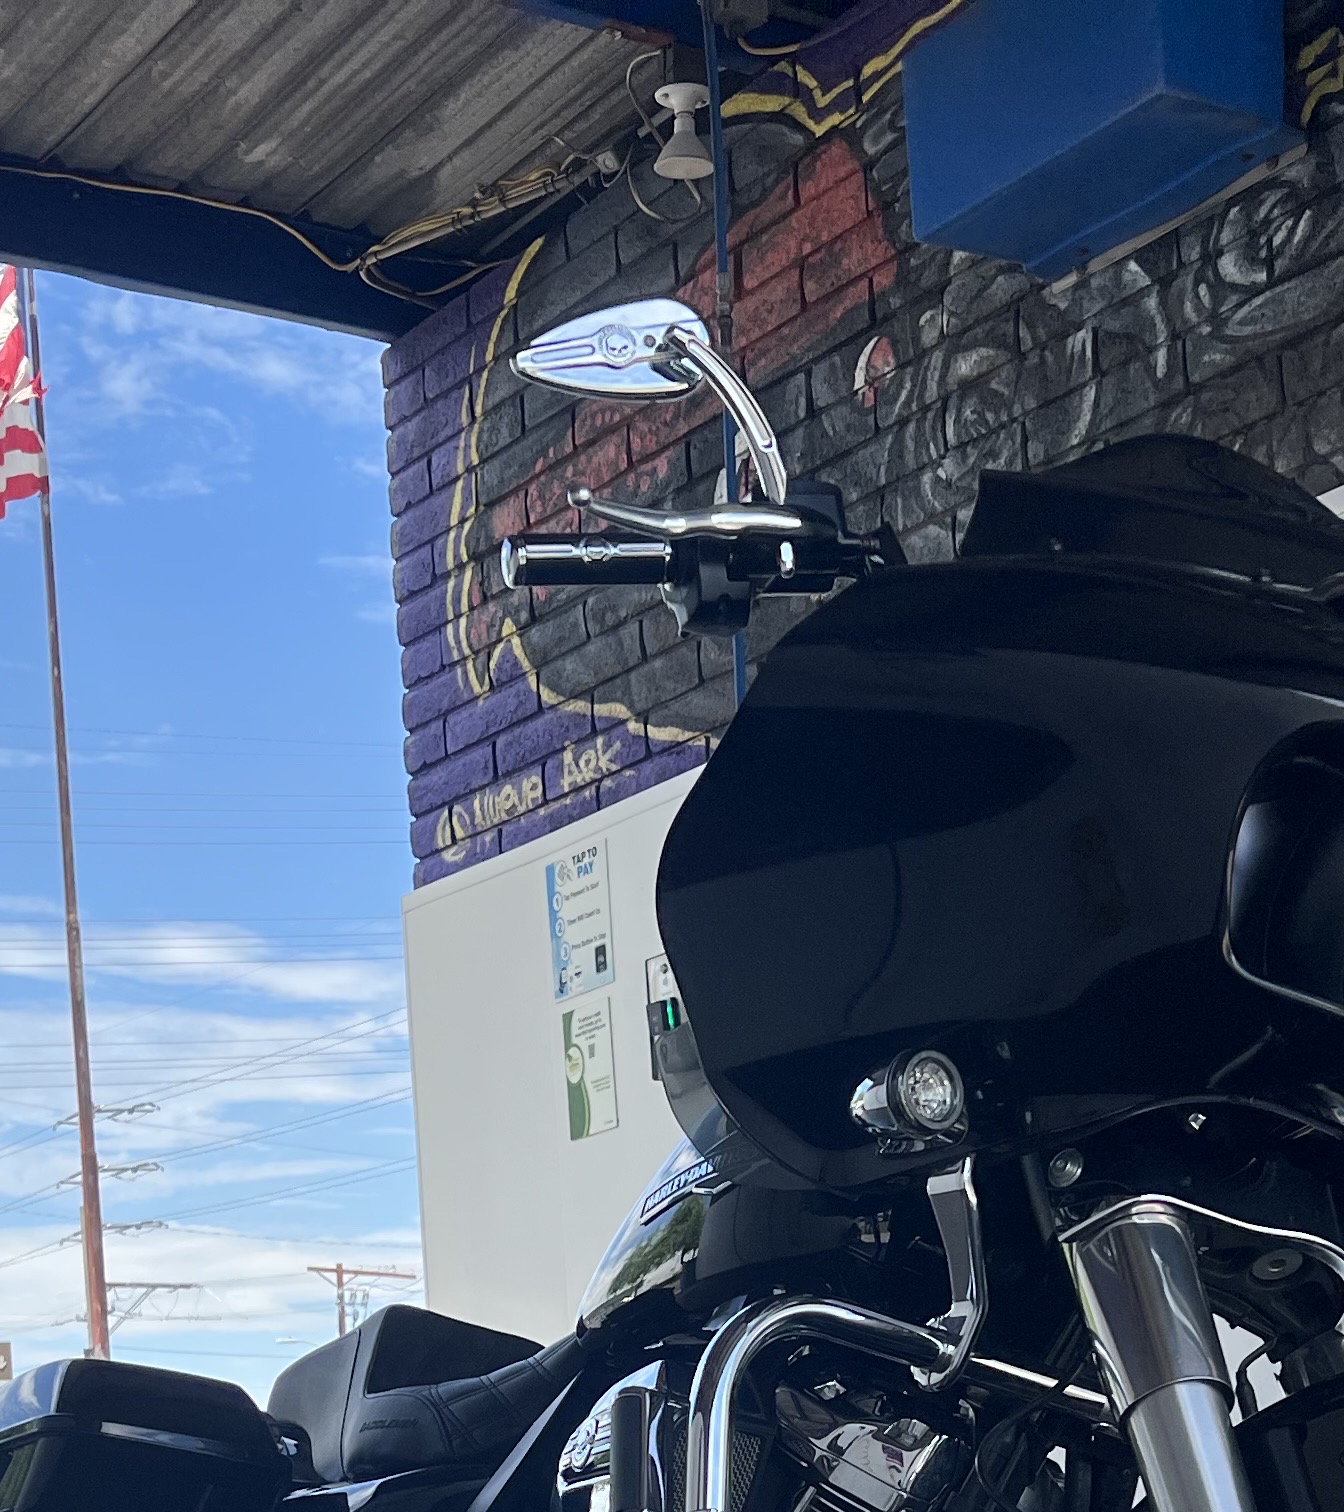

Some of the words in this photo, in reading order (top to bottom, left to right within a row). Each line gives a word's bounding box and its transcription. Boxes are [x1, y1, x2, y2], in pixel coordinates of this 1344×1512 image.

[572, 850, 586, 866] TAP
[587, 846, 598, 860] TO
[576, 860, 595, 879] PAY
